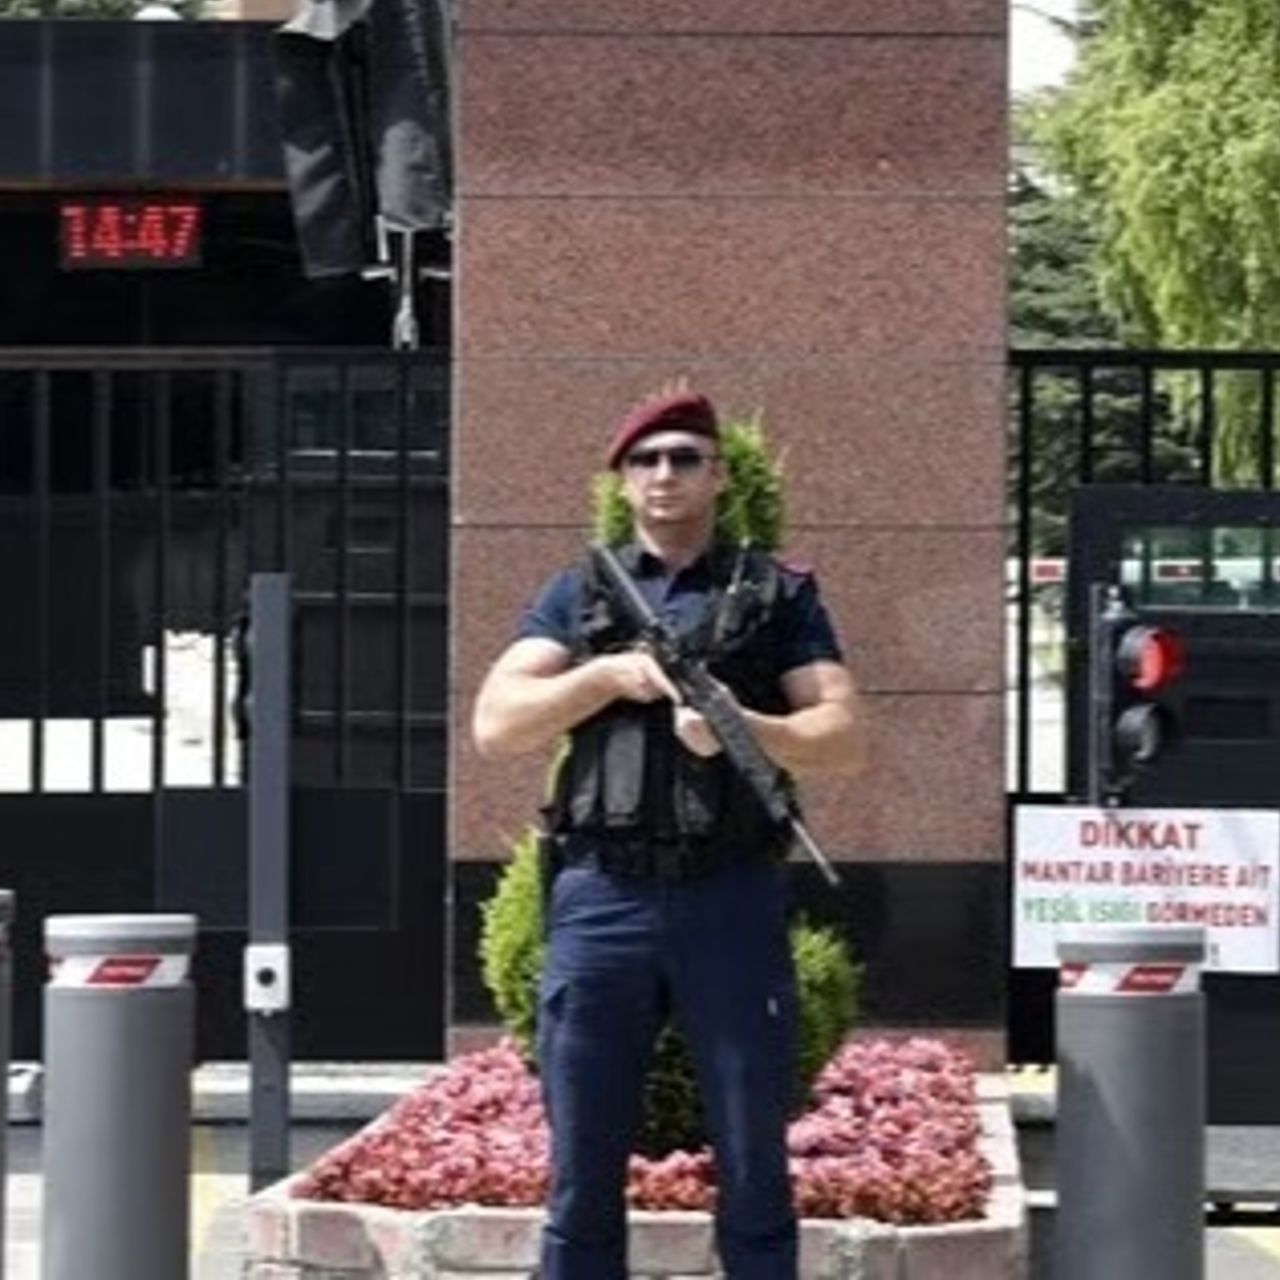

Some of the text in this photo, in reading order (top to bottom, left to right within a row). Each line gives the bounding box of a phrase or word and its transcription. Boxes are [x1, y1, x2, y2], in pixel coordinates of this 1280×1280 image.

[61, 206, 200, 257] 14:47
[1080, 812, 1203, 851] DİKKAT
[1022, 861, 1114, 884] MANTAR
[1145, 894, 1269, 927] GÖRMEDEN
